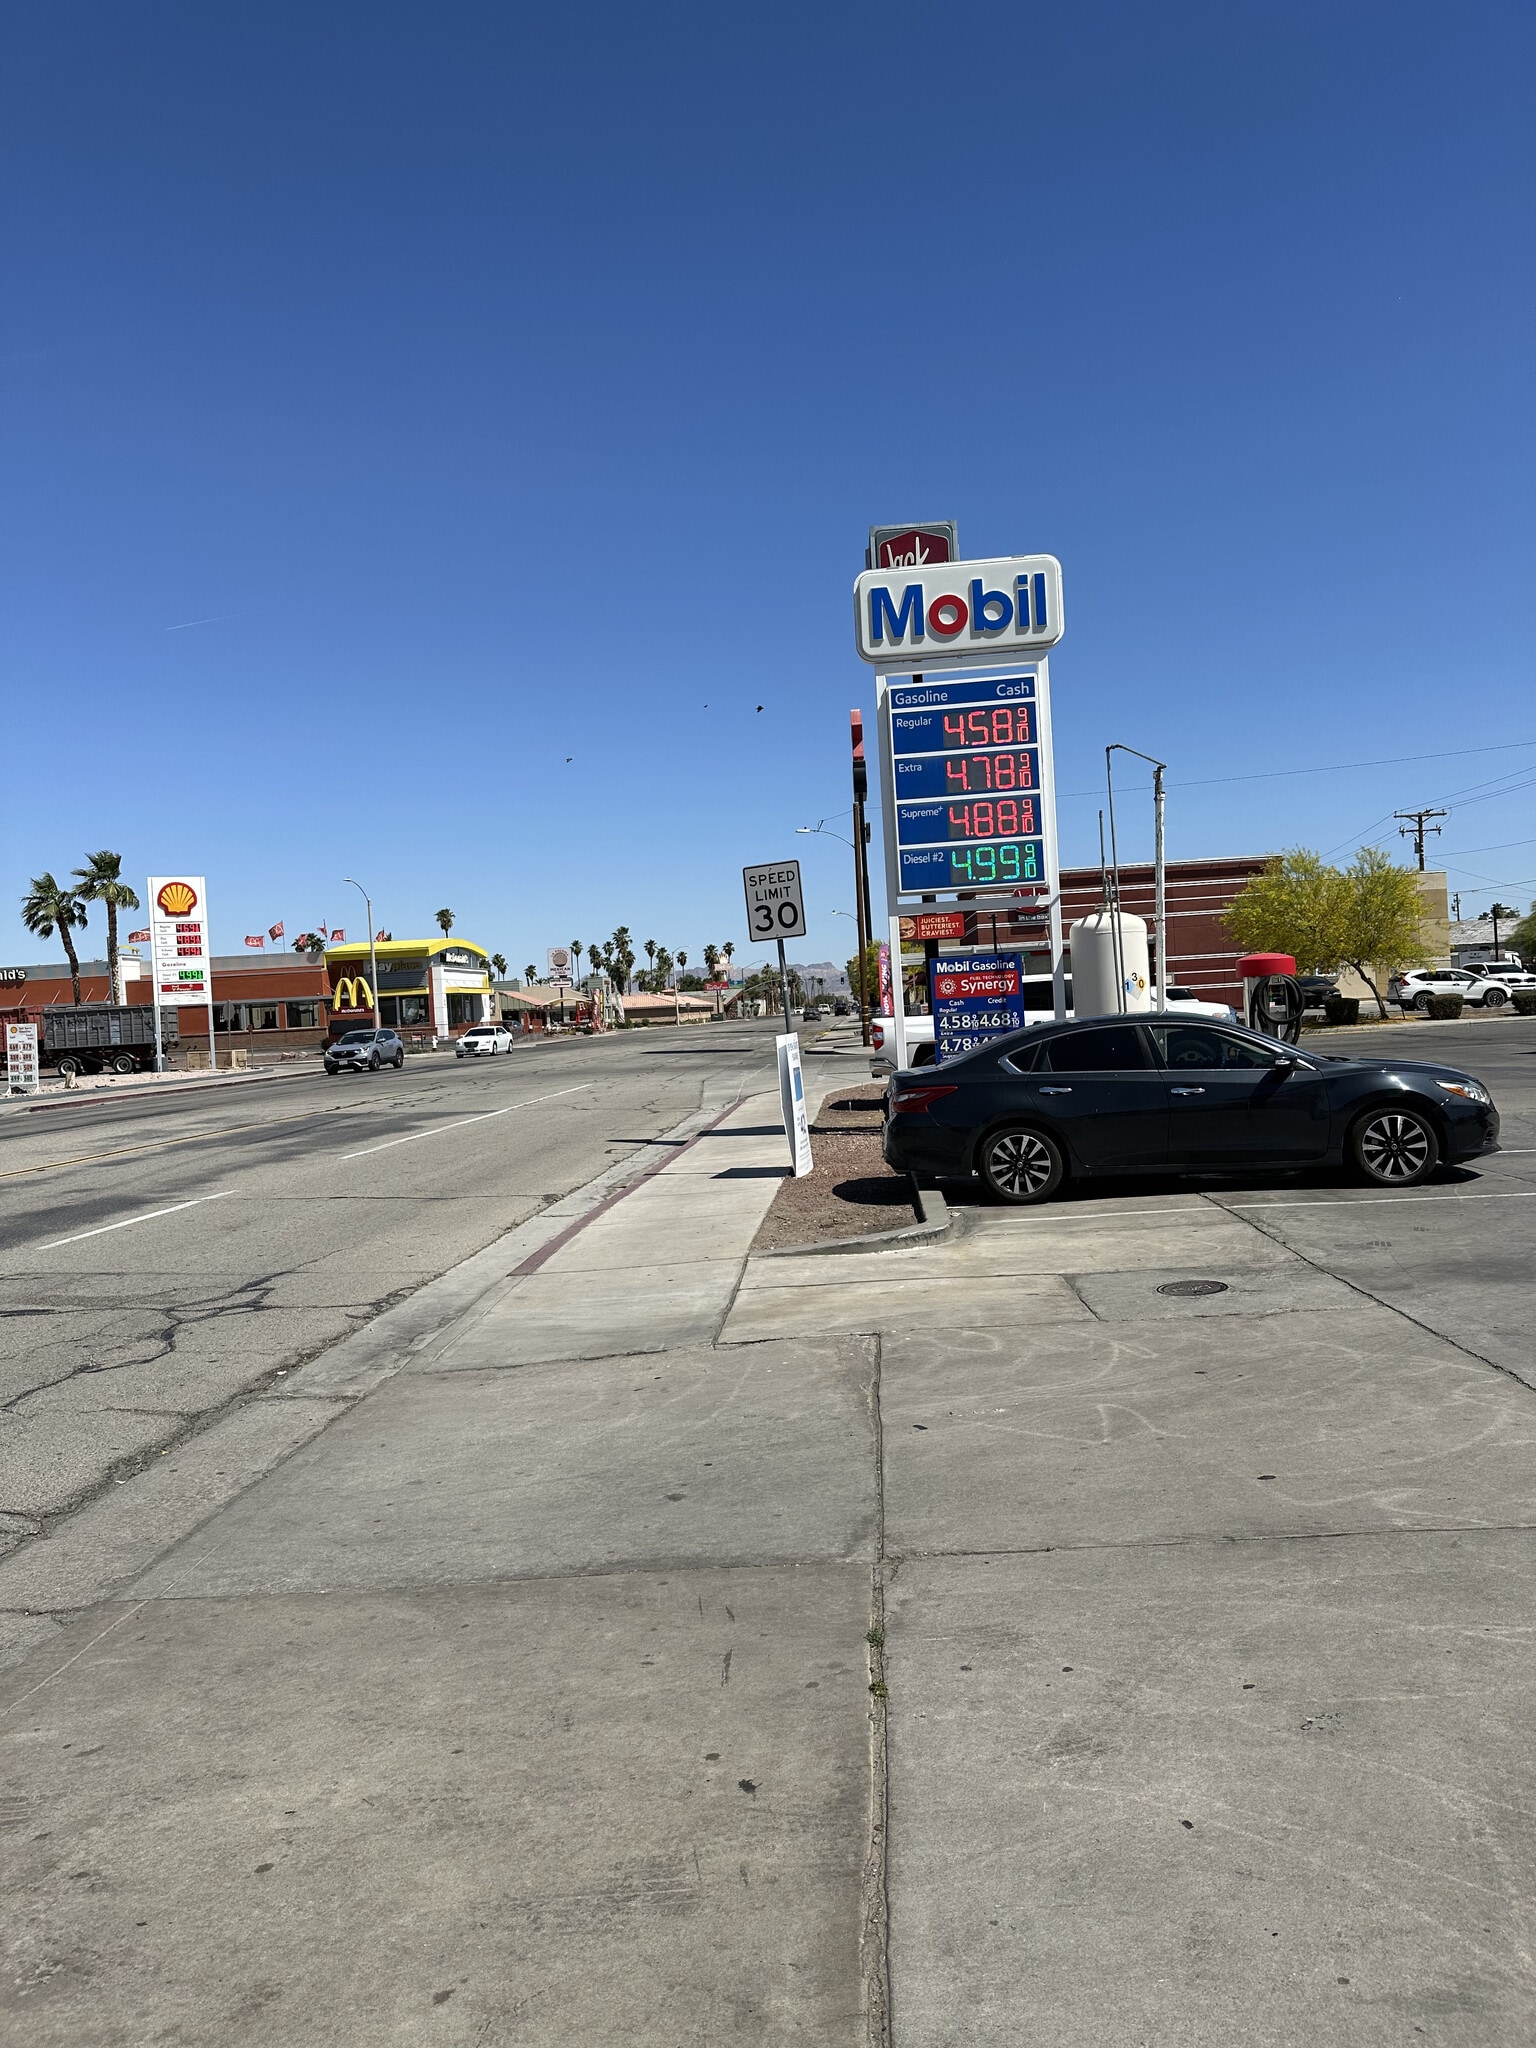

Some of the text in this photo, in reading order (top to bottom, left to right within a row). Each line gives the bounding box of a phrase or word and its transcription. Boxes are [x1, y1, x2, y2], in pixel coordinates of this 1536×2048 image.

[871, 572, 1047, 641] Mobil
[895, 682, 1030, 705] Gasoline Cash
[896, 717, 932, 729] Regular
[943, 709, 1014, 746] 4.58
[898, 763, 922, 773] Extra
[946, 754, 1016, 790] 4.78
[948, 800, 1019, 837] 4.88
[903, 853, 931, 864] Diesel
[932, 852, 944, 862] #2
[951, 844, 1021, 881] 4.99
[749, 870, 795, 887] SPEED
[755, 886, 791, 902] LIMIT
[754, 901, 799, 932] 30
[920, 916, 951, 925] JUICIEST.
[921, 922, 961, 931] BUTTERIEST.
[921, 929, 955, 937] CRAVIEST.
[936, 960, 1015, 973] Mobil Gasoline
[1131, 972, 1138, 981] 3
[1138, 979, 1144, 989] 0
[961, 980, 1015, 994] Synergy
[1125, 981, 1130, 990] 1
[940, 1015, 971, 1029] 4.58
[980, 1013, 1011, 1027] 4.68
[940, 1038, 972, 1052] 4.78
